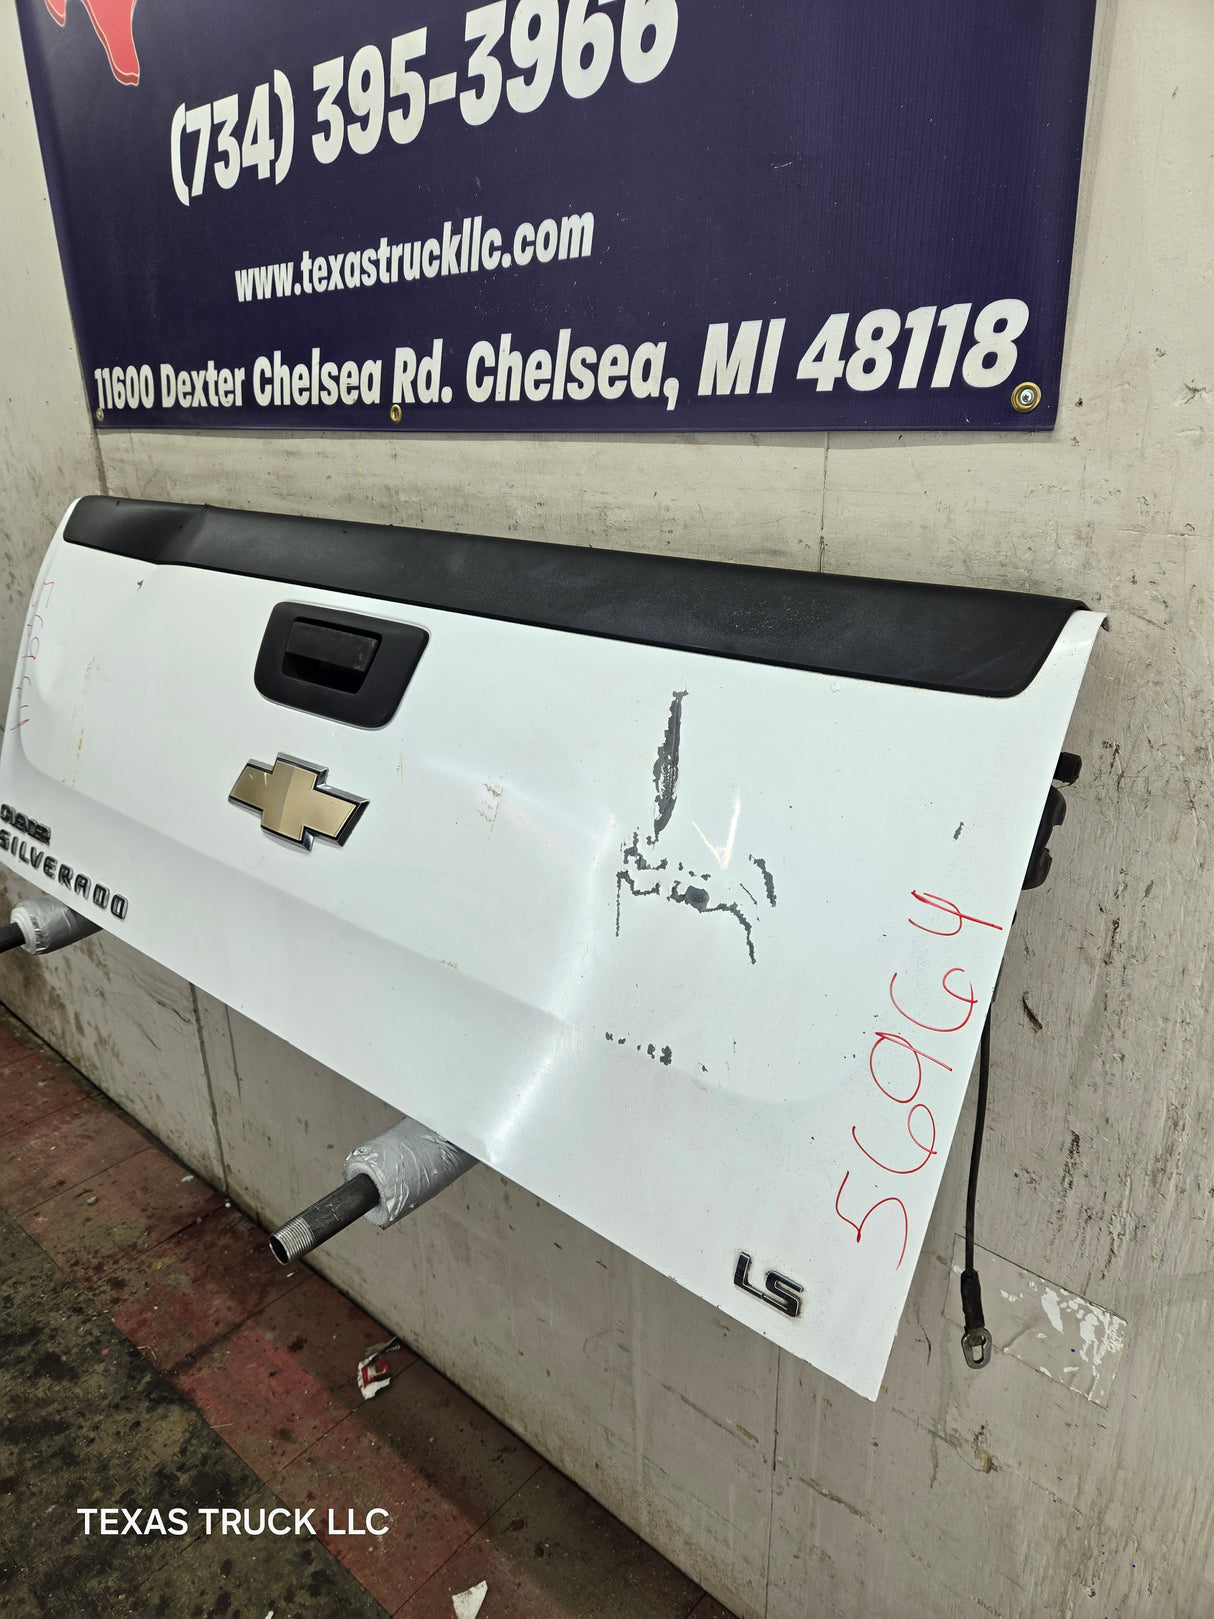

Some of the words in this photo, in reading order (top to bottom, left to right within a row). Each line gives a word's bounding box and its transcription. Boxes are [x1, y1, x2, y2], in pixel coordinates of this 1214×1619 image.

[171, 69, 294, 206] (734)
[312, 0, 679, 164] 395-3966
[235, 212, 594, 302] www.texastruckllc.com
[94, 364, 155, 409] 11600
[160, 360, 246, 408] Dexter
[253, 347, 382, 406] Chelsea
[392, 338, 453, 404] Rd.
[466, 329, 679, 411] Chelsea,
[698, 318, 786, 396] MI
[796, 298, 1029, 392] 48118
[0, 829, 129, 921] SILVERADO
[733, 1251, 804, 1318] LS
